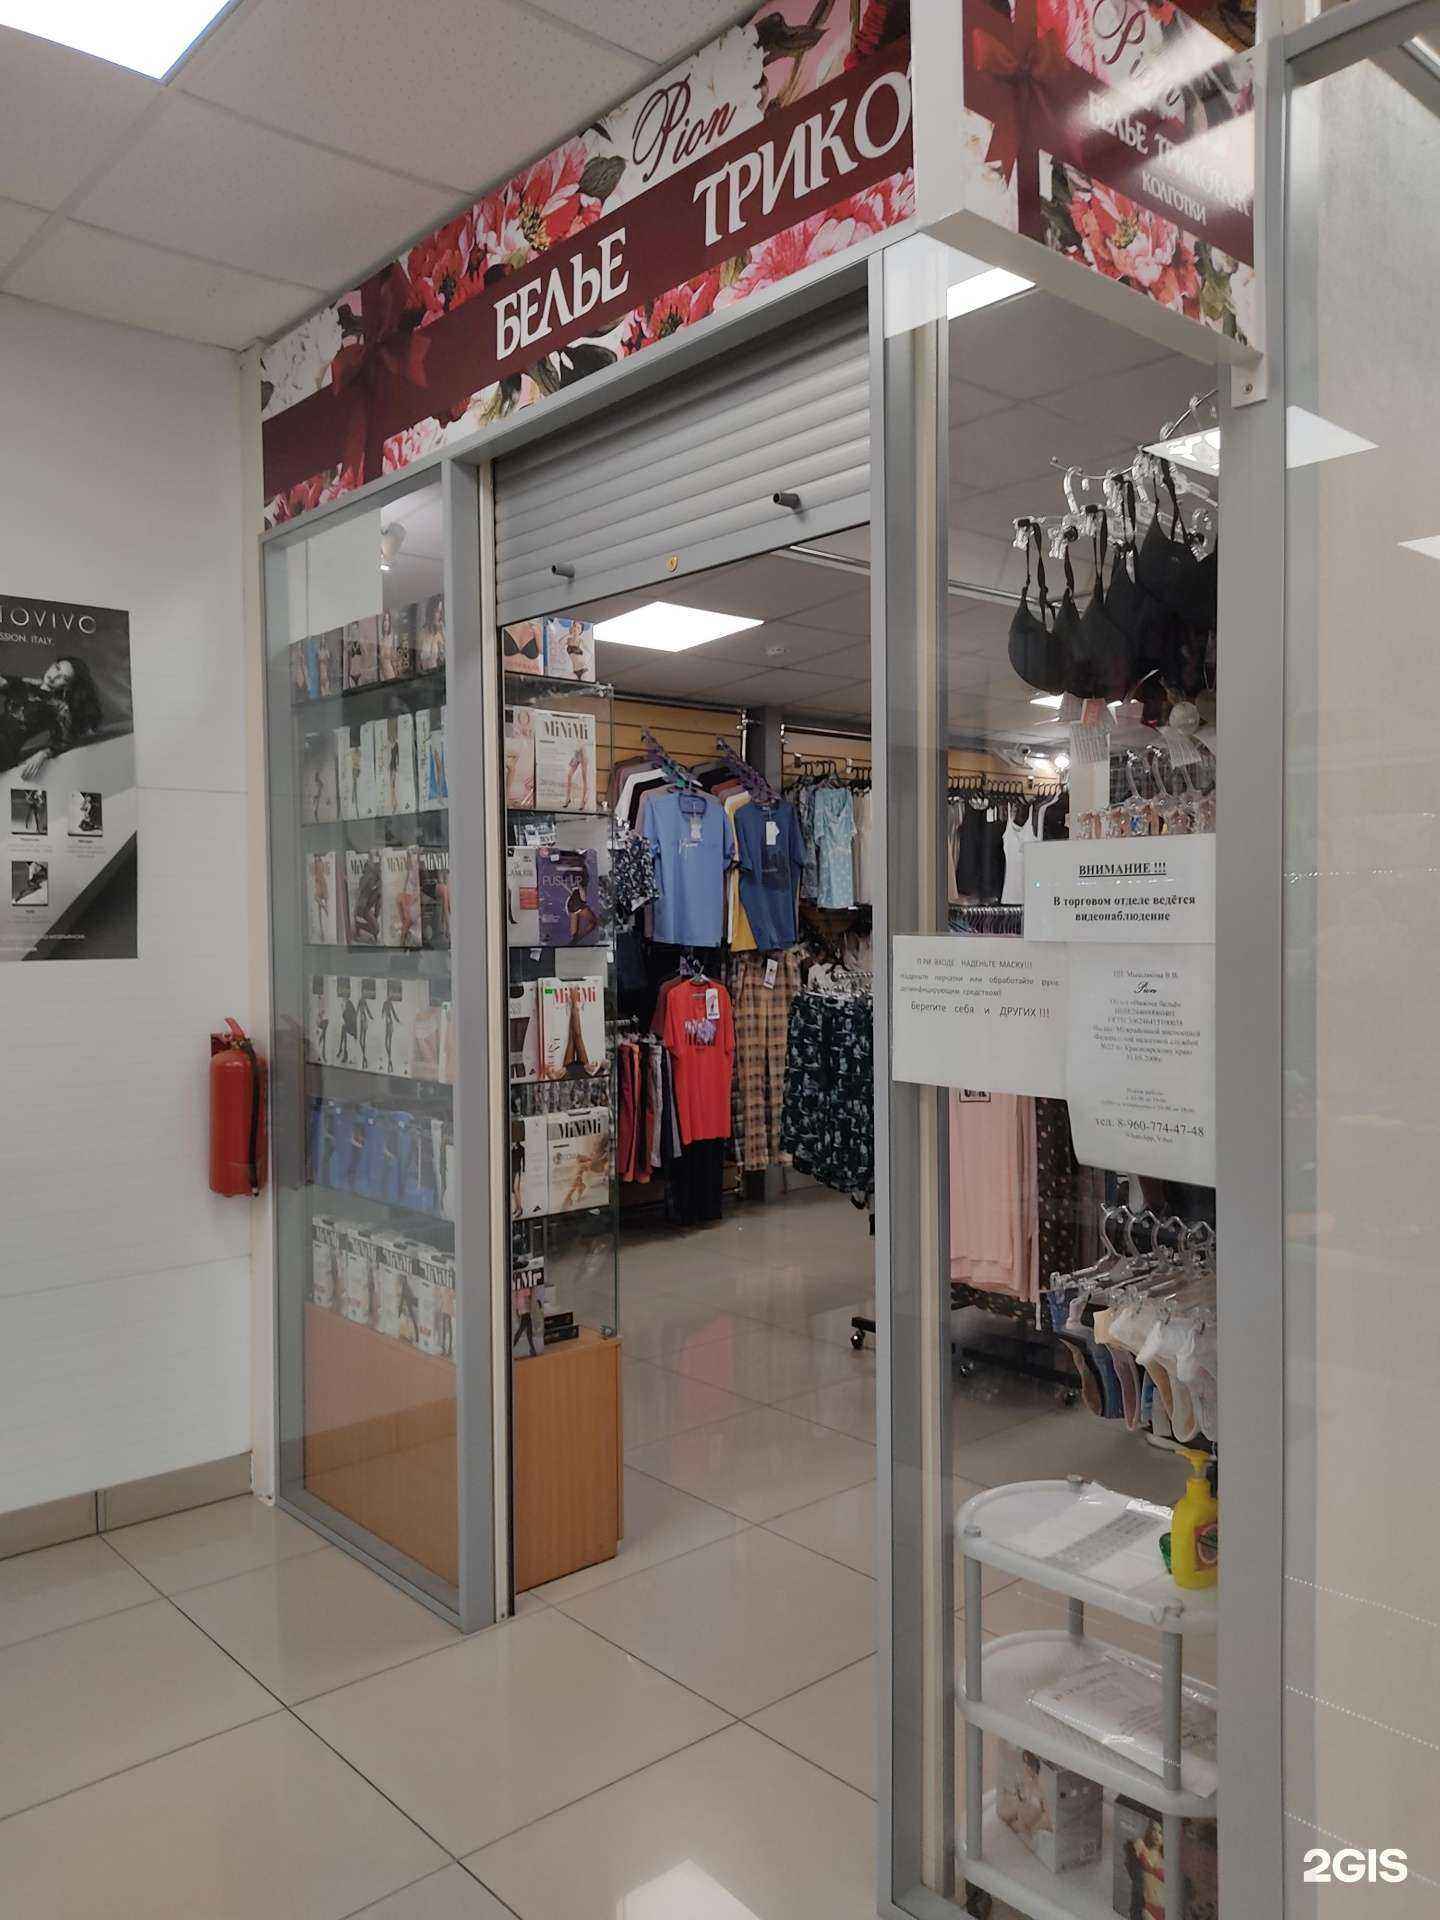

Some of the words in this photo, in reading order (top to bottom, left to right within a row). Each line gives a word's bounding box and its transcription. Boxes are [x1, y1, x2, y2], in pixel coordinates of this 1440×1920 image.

[632, 73, 737, 183] Pion
[1141, 170, 1207, 226] КОЛГОТКИ
[493, 227, 630, 361] БЕЛЬЕ
[692, 70, 913, 248] ТРИКО
[1079, 862, 1151, 877] ВНИМАНИЕ
[1054, 897, 1061, 906] В
[1064, 897, 1112, 908] торговом
[1115, 896, 1150, 907] отделе
[1153, 894, 1196, 906] ведётся
[1075, 911, 1171, 922] видеонаблюдение
[910, 1000, 947, 1013] Берегите
[954, 1002, 975, 1015] себя
[984, 1006, 992, 1015] и
[559, 1118, 601, 1139] MiNiMi
